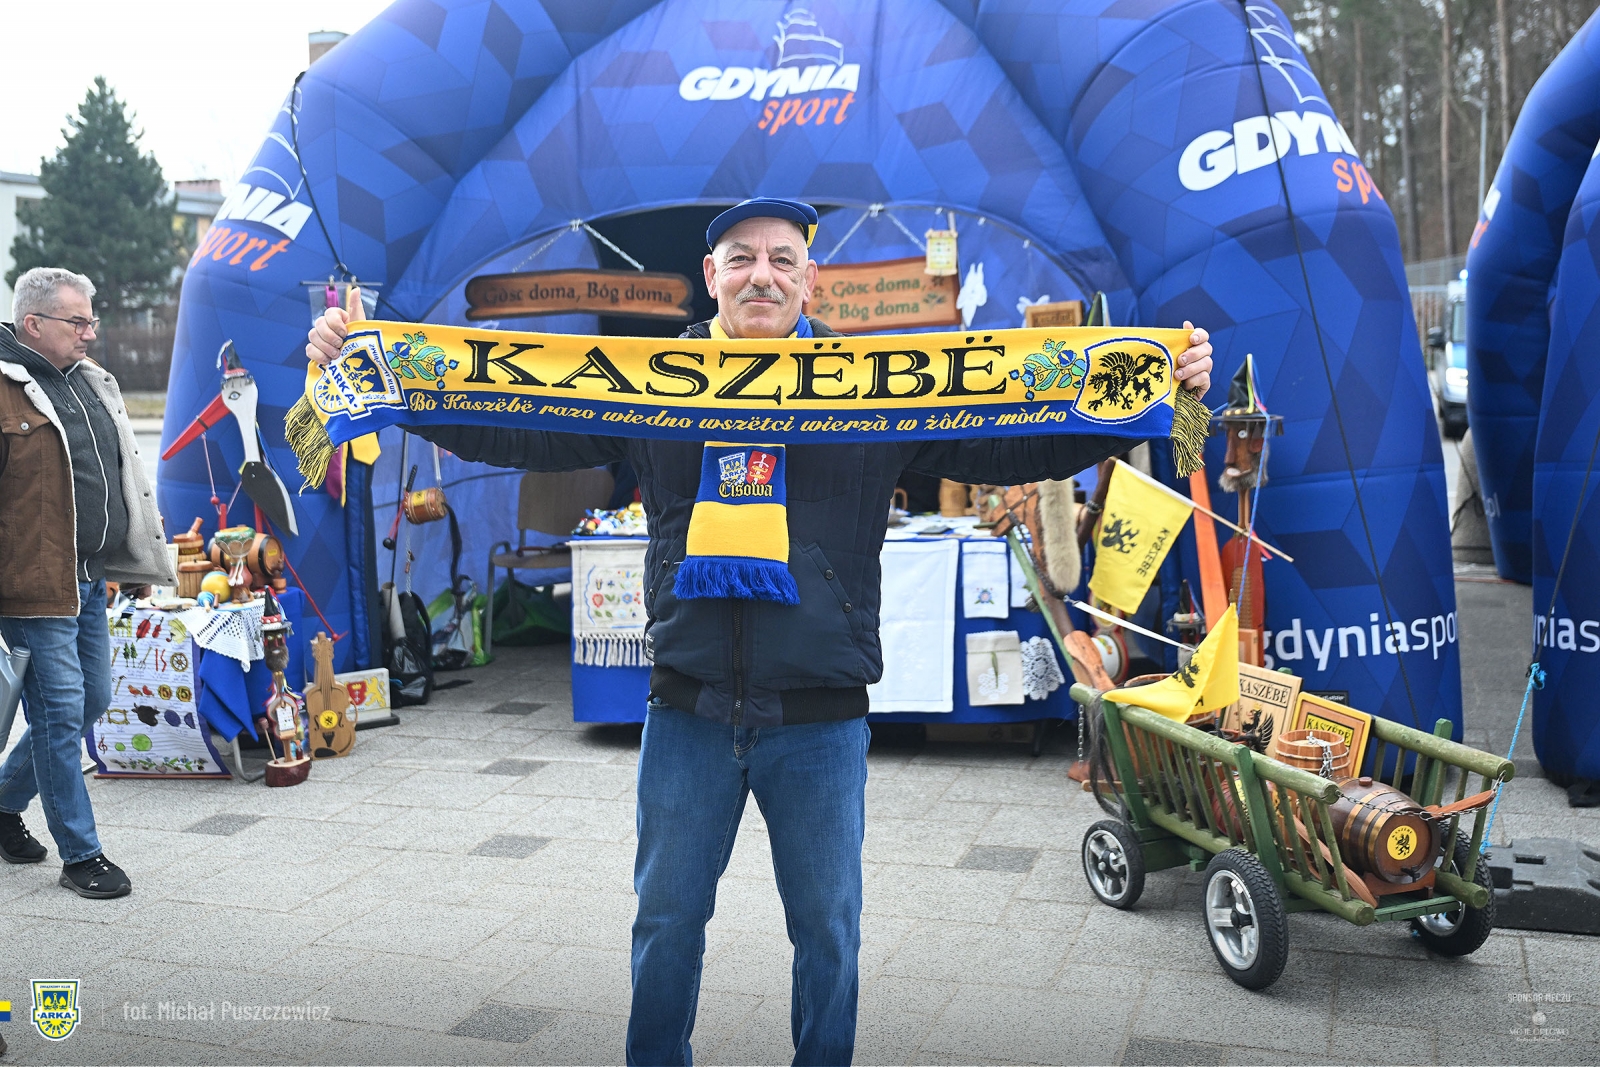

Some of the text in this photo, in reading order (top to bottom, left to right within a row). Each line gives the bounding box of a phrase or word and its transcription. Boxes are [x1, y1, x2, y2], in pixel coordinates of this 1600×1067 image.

[679, 63, 861, 101] GDYNIA
[758, 92, 856, 136] sport
[1178, 110, 1359, 191] GDYN
[215, 182, 314, 241] NIA
[191, 225, 291, 272] port
[529, 283, 581, 303] doma,
[587, 281, 620, 304] Bóg
[625, 283, 674, 303] doma
[875, 277, 926, 293] doma,
[839, 300, 920, 321] Bóg doma
[328, 364, 358, 406] ARKA
[463, 335, 1009, 406] KASZËBË
[409, 391, 438, 411] Bò
[443, 393, 536, 414] Kaszëbë
[538, 404, 597, 419] razo
[601, 409, 694, 429] wiedno
[698, 415, 795, 432] wszëtci
[800, 414, 890, 432] wierzà
[896, 416, 919, 431] w
[719, 480, 773, 498] Cisowa
[724, 469, 745, 479] ARKA
[1239, 678, 1289, 704] KASZËBË
